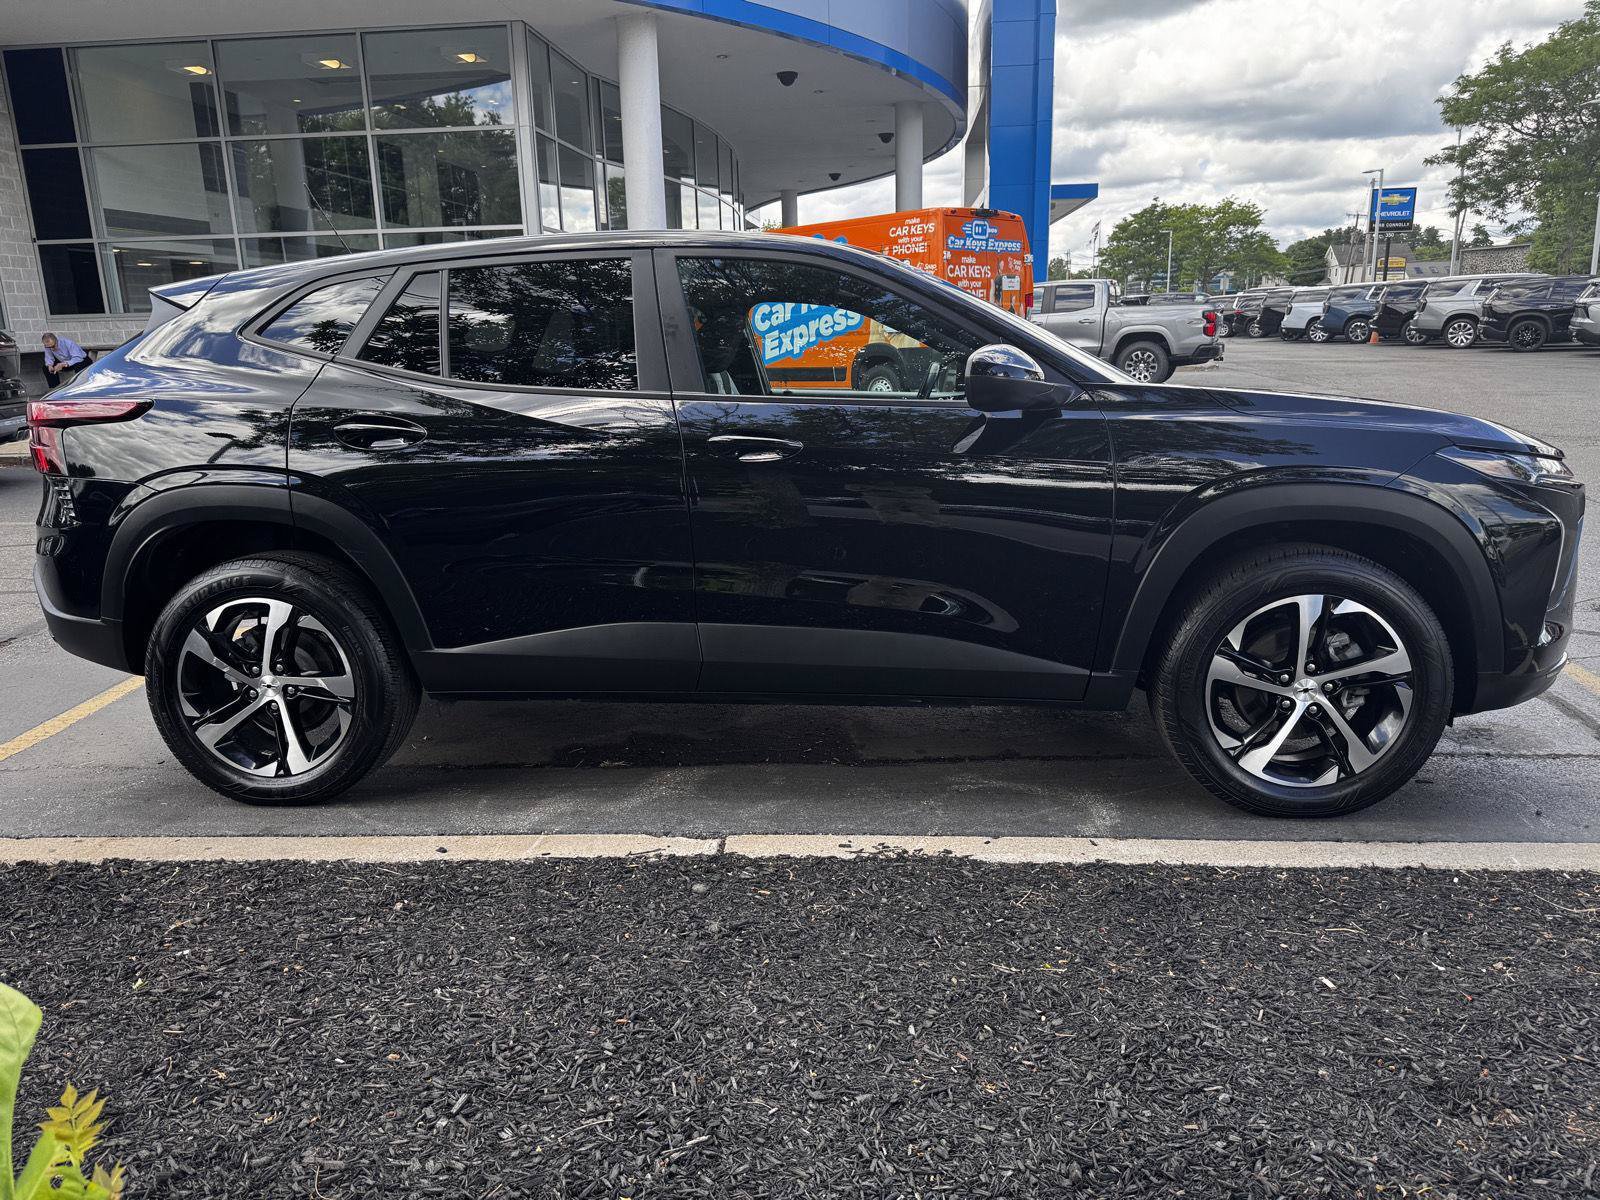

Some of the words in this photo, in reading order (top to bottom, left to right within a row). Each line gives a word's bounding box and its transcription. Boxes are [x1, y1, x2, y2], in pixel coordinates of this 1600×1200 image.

[905, 217, 920, 225] make
[889, 226, 908, 237] CAR
[910, 223, 935, 234] KEYS
[892, 242, 928, 255] PHONE!
[948, 236, 964, 248] Car
[965, 238, 987, 252] Keys
[988, 239, 1021, 252] Express
[961, 255, 976, 264] make
[947, 264, 967, 278] CAR
[968, 265, 991, 278] KEYS
[958, 279, 970, 288] with
[970, 281, 983, 289] your
[754, 303, 795, 332] Car
[765, 309, 860, 360] Express
